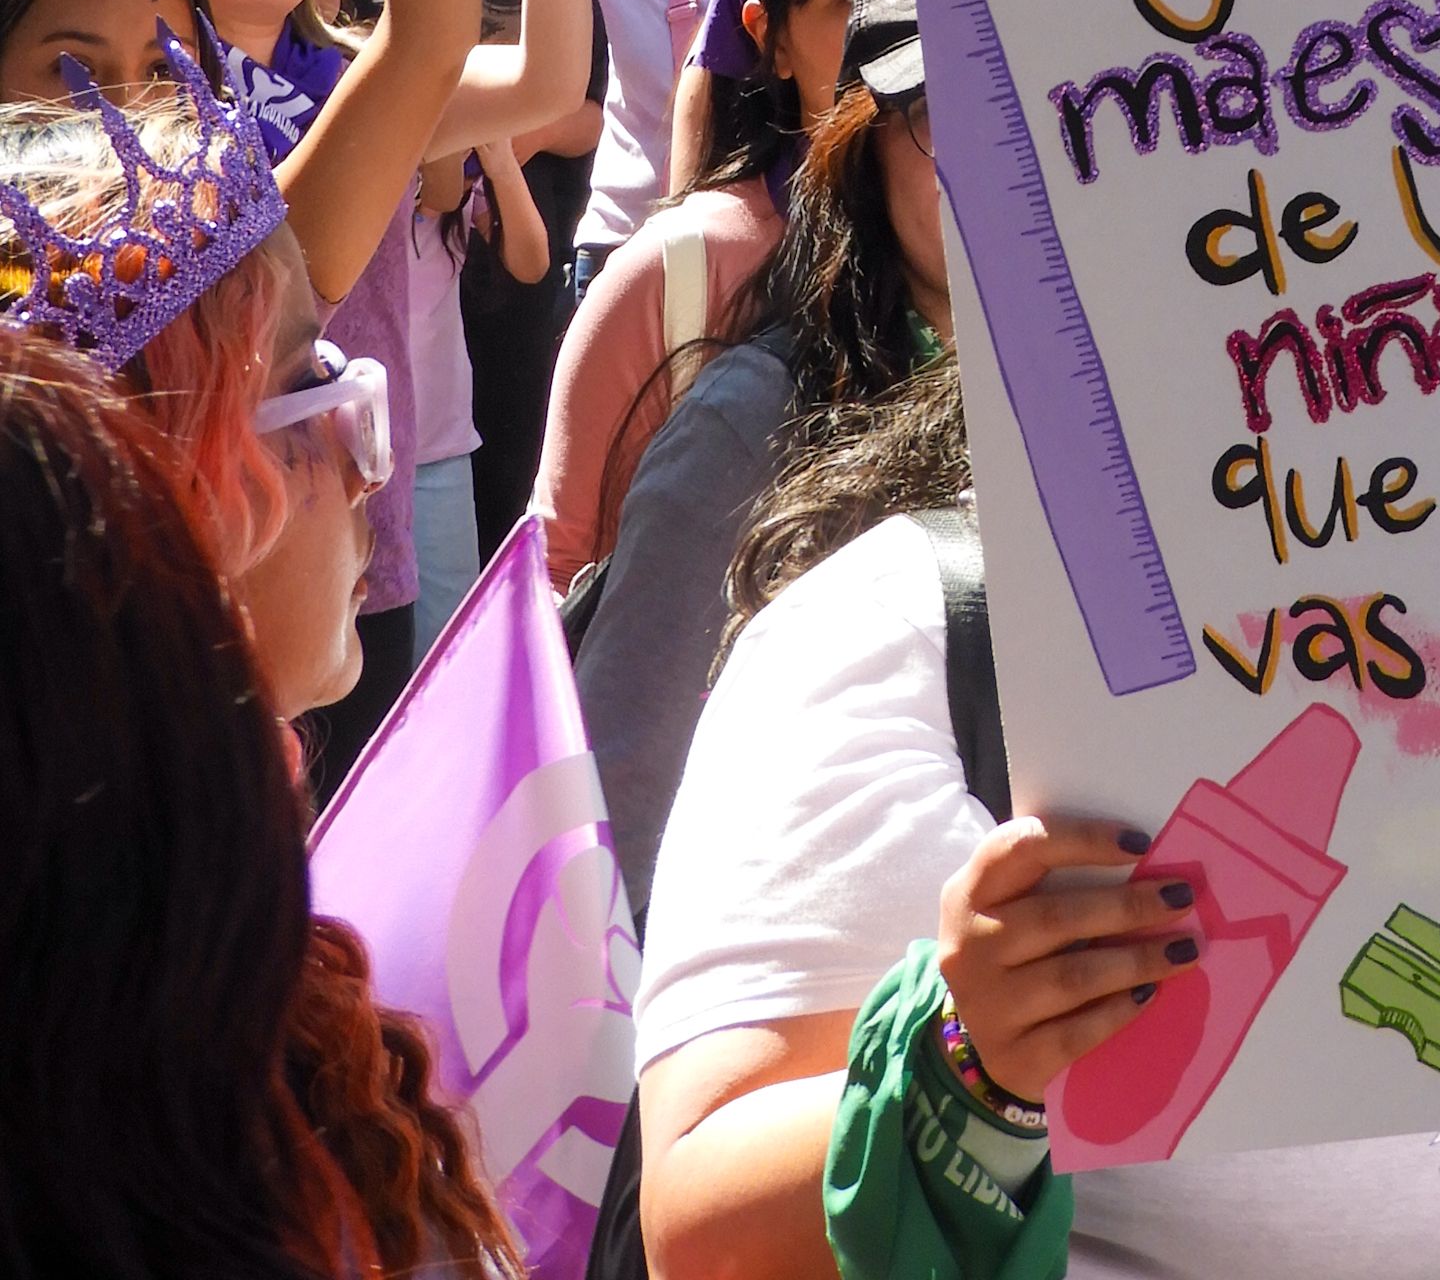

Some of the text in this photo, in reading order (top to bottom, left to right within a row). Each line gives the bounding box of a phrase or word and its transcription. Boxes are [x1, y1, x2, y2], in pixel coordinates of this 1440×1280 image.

[1186, 167, 1360, 297] de
[1211, 435, 1437, 564] que
[1202, 592, 1429, 698] vas
